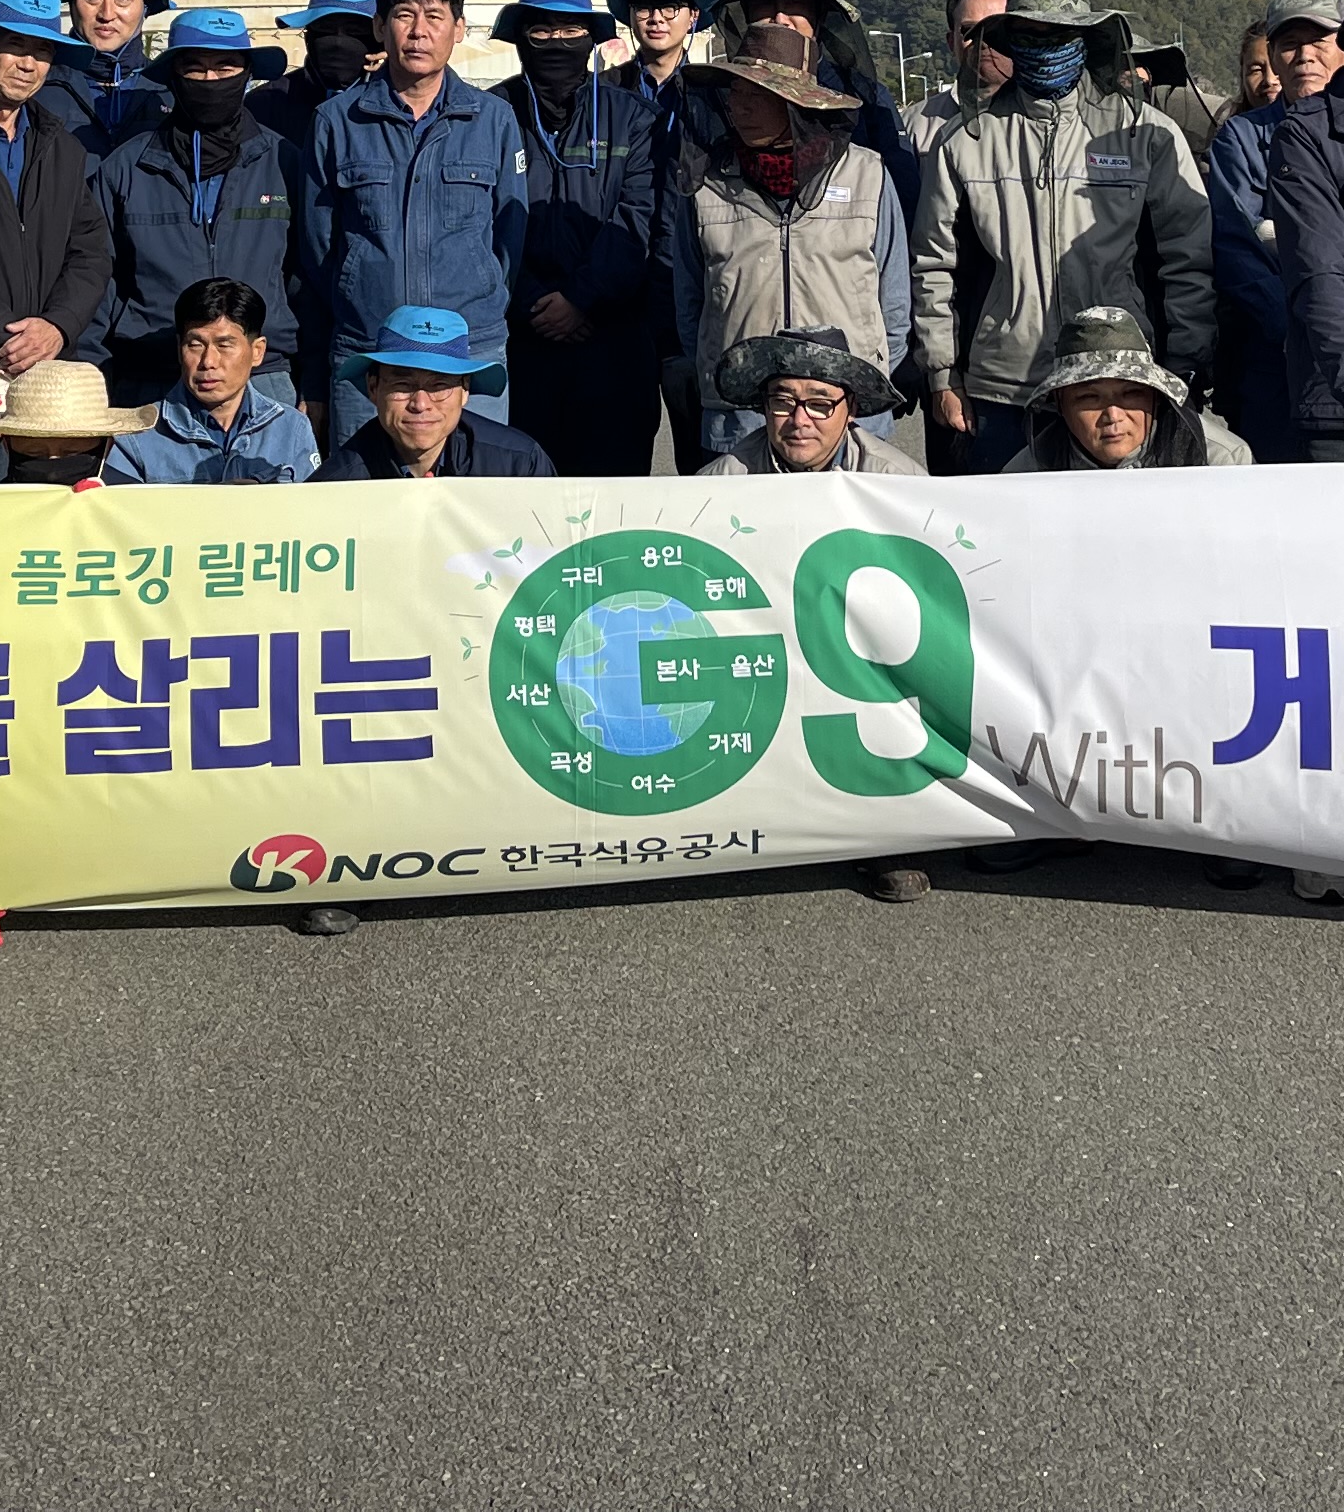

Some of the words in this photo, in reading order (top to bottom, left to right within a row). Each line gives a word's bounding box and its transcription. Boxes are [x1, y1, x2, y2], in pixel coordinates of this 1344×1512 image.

[640, 546, 683, 568] 용인
[11, 545, 173, 606] 플로깅
[198, 538, 357, 598] 릴레이
[561, 566, 603, 588] 구리
[704, 577, 747, 600] 동해
[514, 615, 556, 637] 평택
[656, 659, 701, 682] 본사
[731, 655, 775, 678] 울산
[506, 684, 552, 706] 서산
[57, 629, 439, 776] 살리는
[985, 724, 1204, 824] With
[708, 732, 752, 755] 거제
[550, 751, 593, 774] 곡성
[631, 774, 676, 795] 여수
[229, 833, 487, 893] KNOC
[500, 829, 765, 872] 한국석유공사
